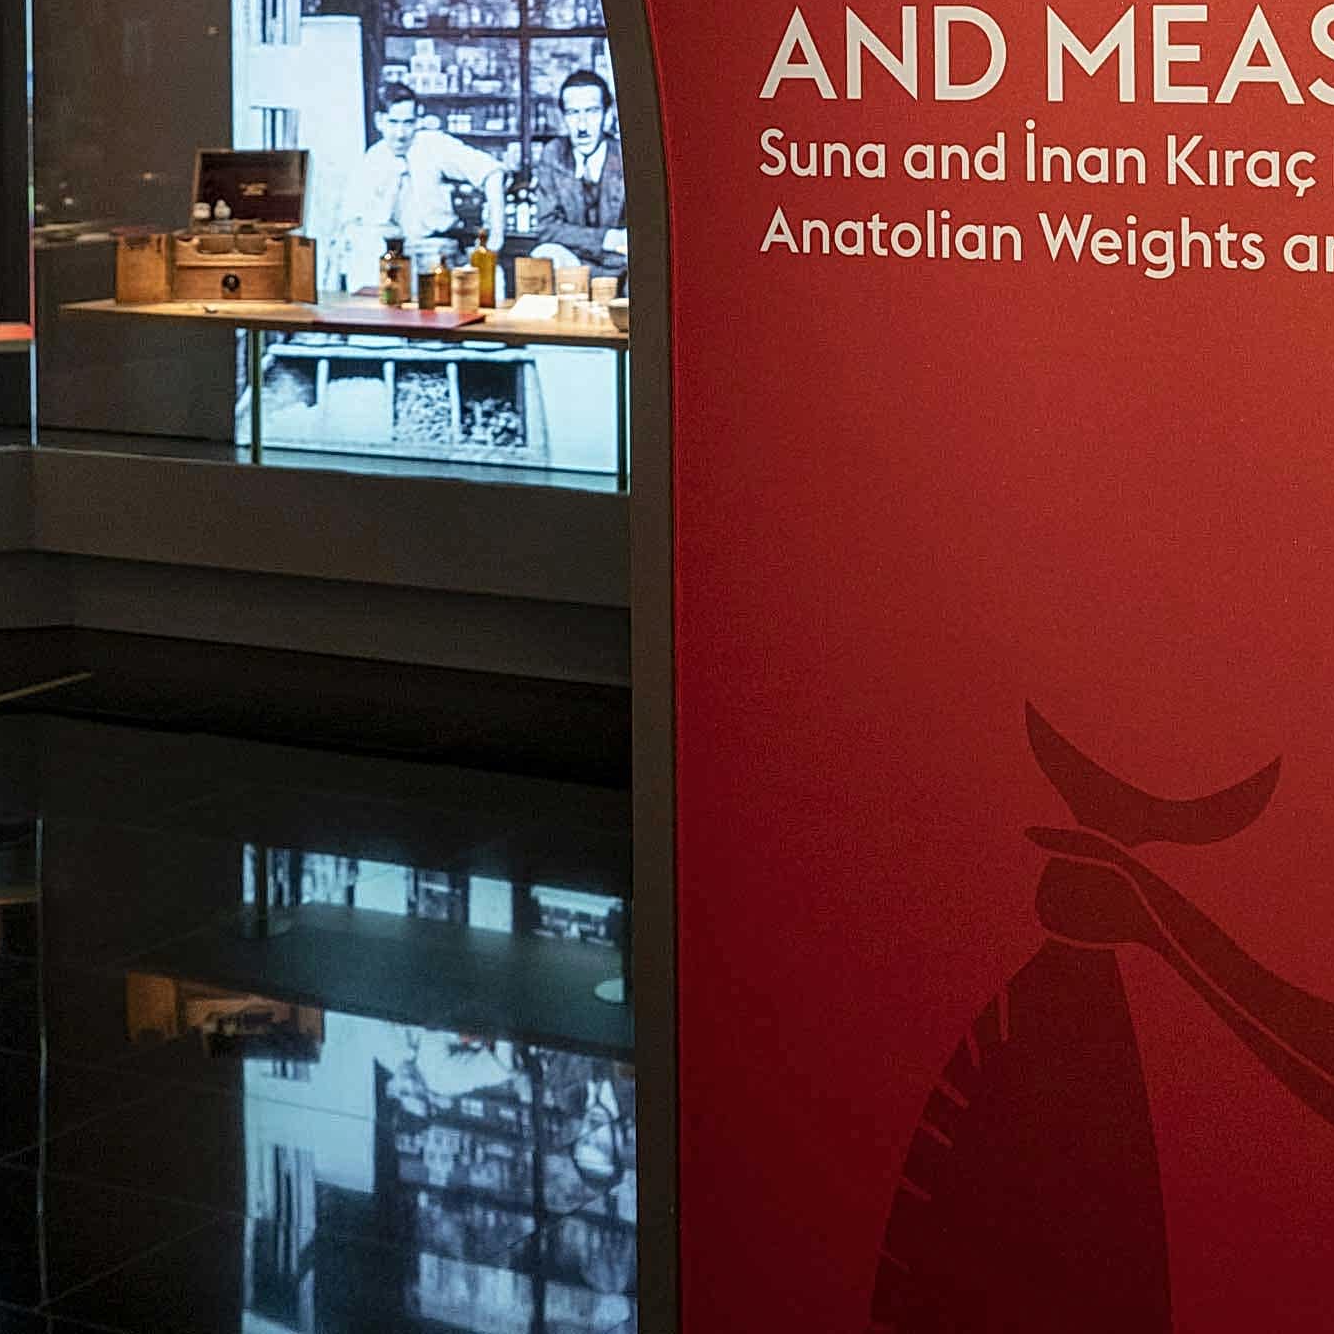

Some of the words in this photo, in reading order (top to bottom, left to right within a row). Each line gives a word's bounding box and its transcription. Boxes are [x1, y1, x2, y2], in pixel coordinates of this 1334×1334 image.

[759, 5, 1007, 101] AND
[759, 128, 886, 179] Suna
[903, 131, 1006, 181] and
[1026, 118, 1146, 185] İnan
[1167, 134, 1317, 198] Kıraç
[760, 206, 1022, 261] Anatolian
[1038, 212, 1266, 279] Weights
